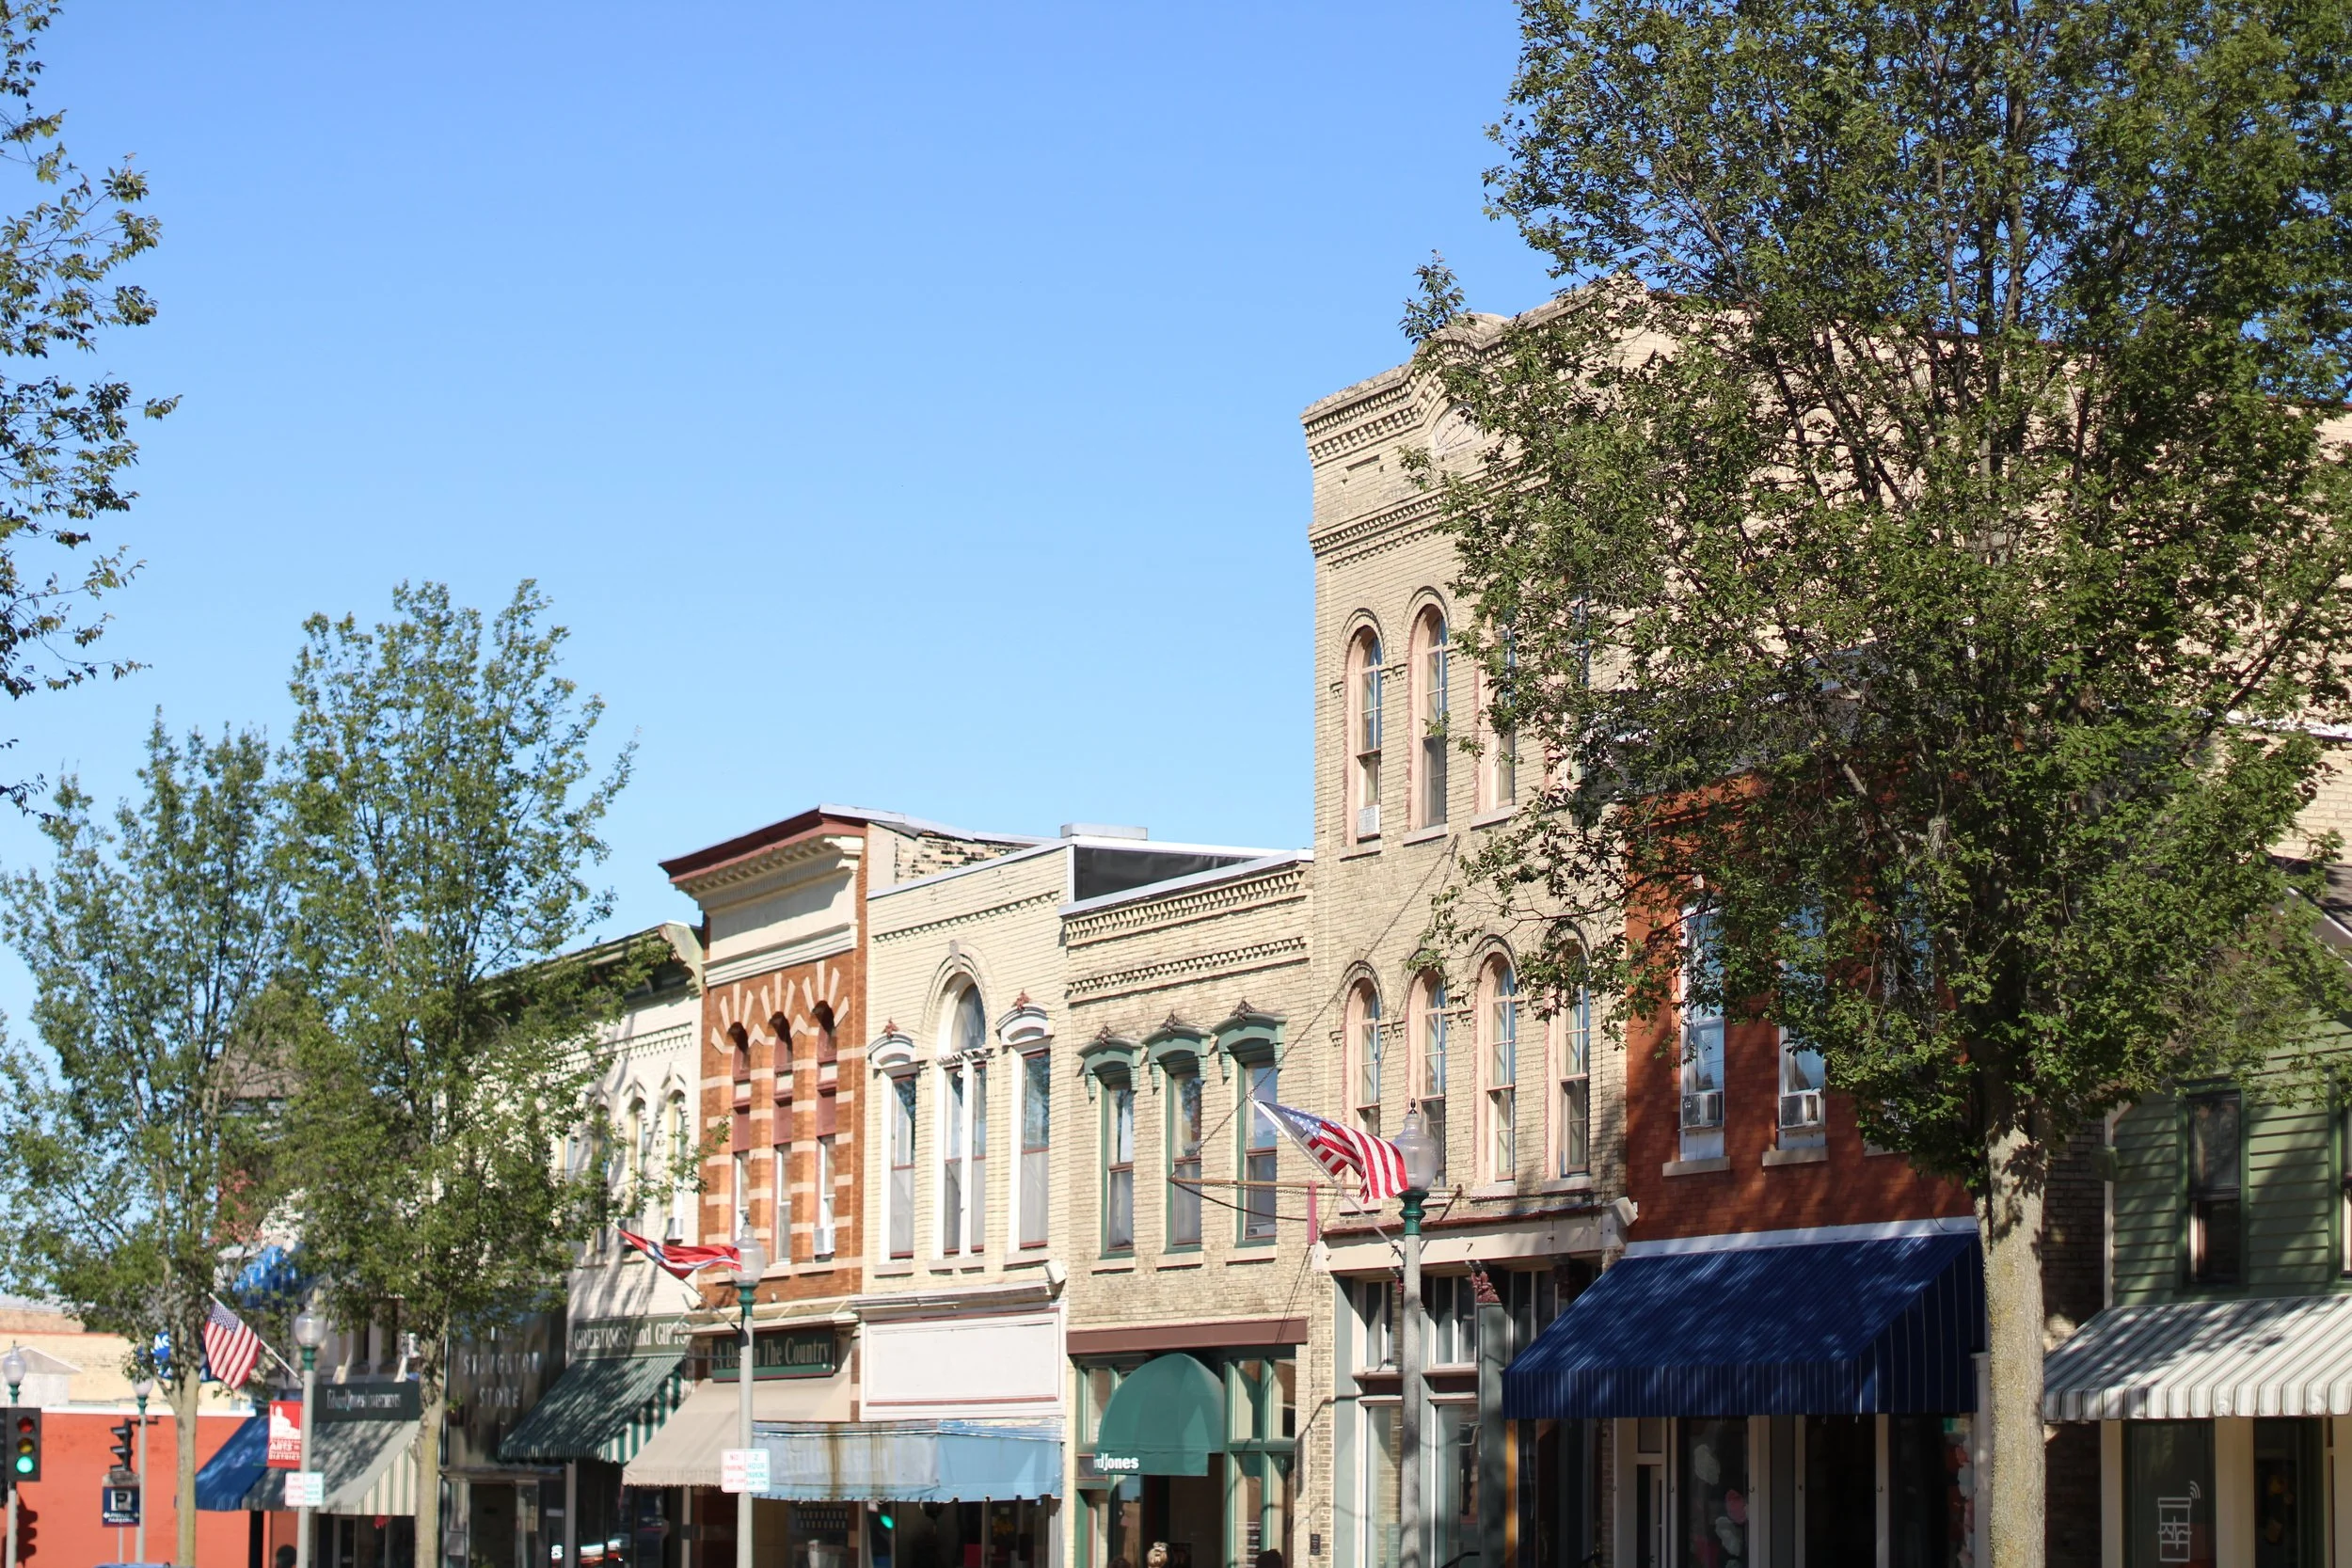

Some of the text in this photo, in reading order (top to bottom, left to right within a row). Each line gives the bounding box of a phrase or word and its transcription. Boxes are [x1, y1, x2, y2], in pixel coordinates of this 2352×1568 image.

[633, 1323, 652, 1346] and
[763, 1338, 783, 1367] The
[785, 1337, 831, 1365] Country
[478, 1386, 520, 1409] STORE
